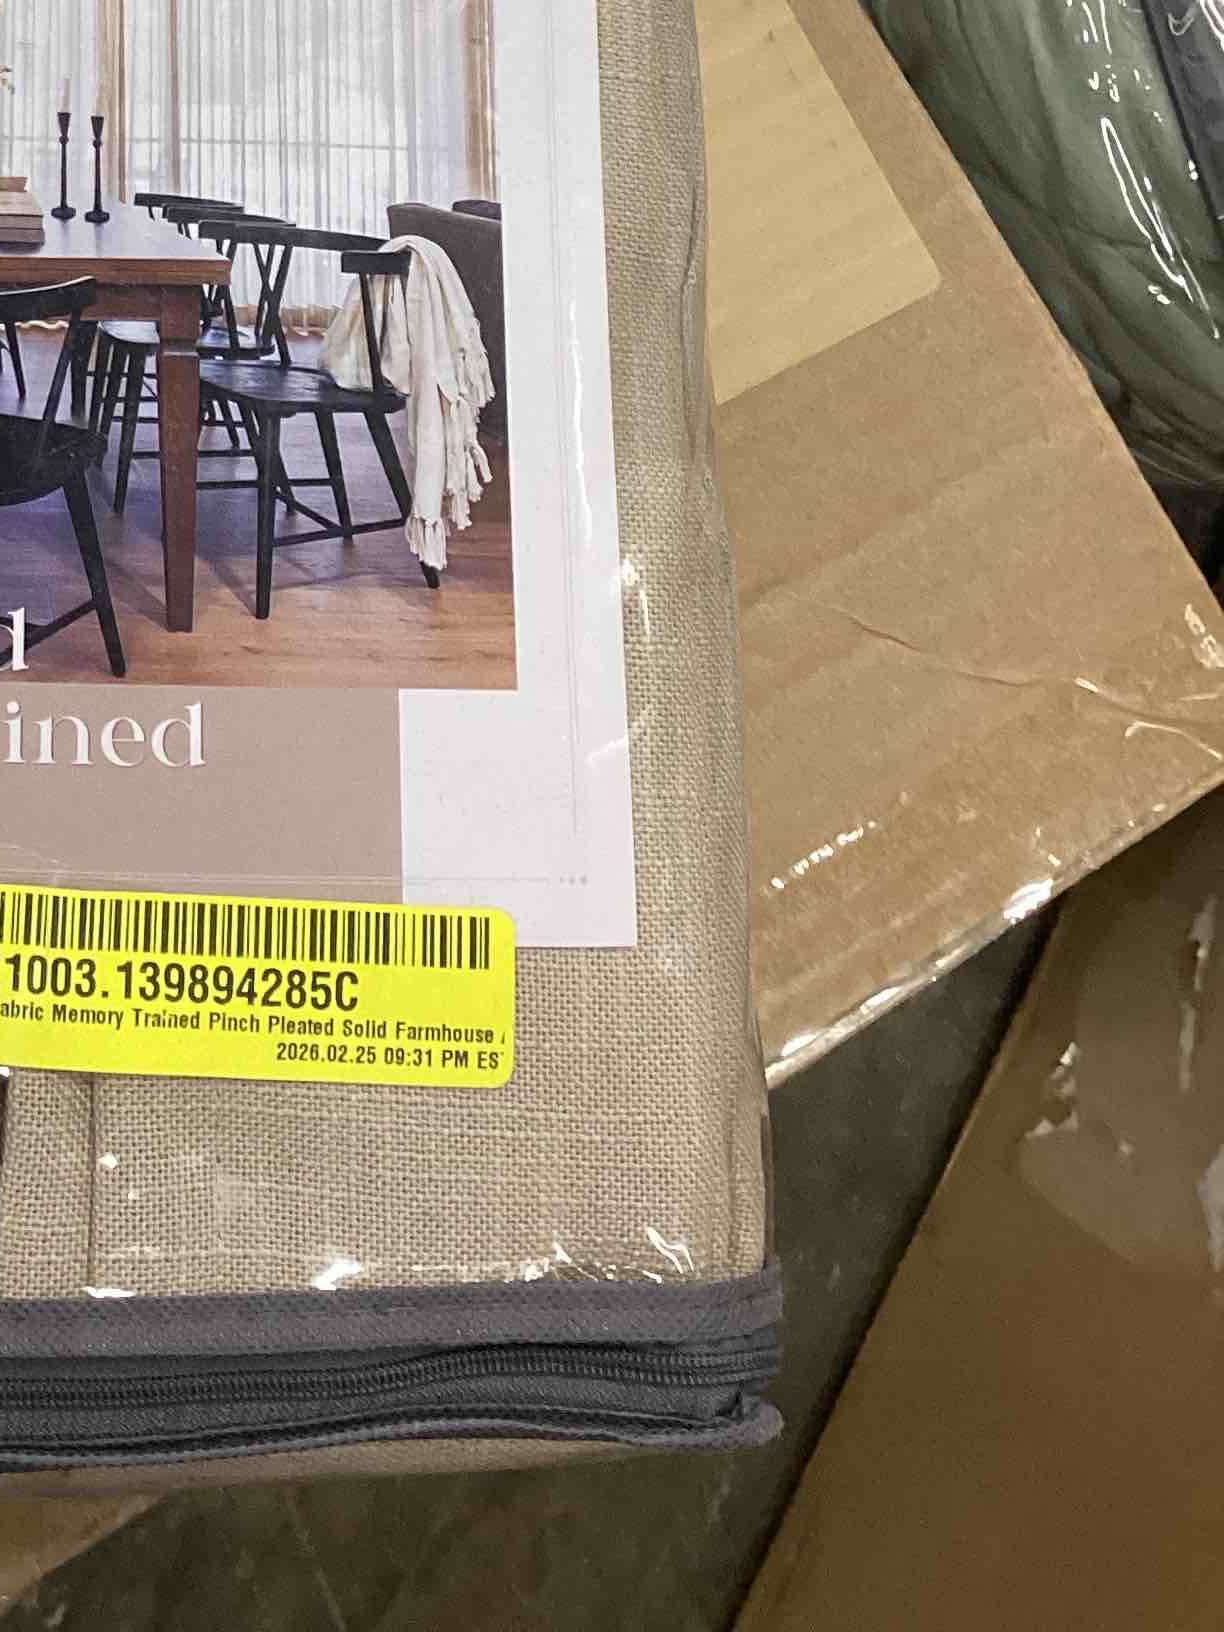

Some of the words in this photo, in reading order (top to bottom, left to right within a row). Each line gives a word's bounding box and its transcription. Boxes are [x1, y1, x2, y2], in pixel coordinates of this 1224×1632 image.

[51, 1003, 124, 1031] Memory
[132, 1007, 201, 1030] Trained
[208, 1011, 261, 1034] Pinch
[267, 1015, 335, 1037] Pleated
[342, 1018, 387, 1040] Solid
[395, 1021, 495, 1044] Farmhouse
[276, 1042, 377, 1065] 2026.02.25
[384, 1046, 433, 1067] 09:31
[441, 1049, 469, 1069] PM
[477, 1050, 505, 1070] ES
